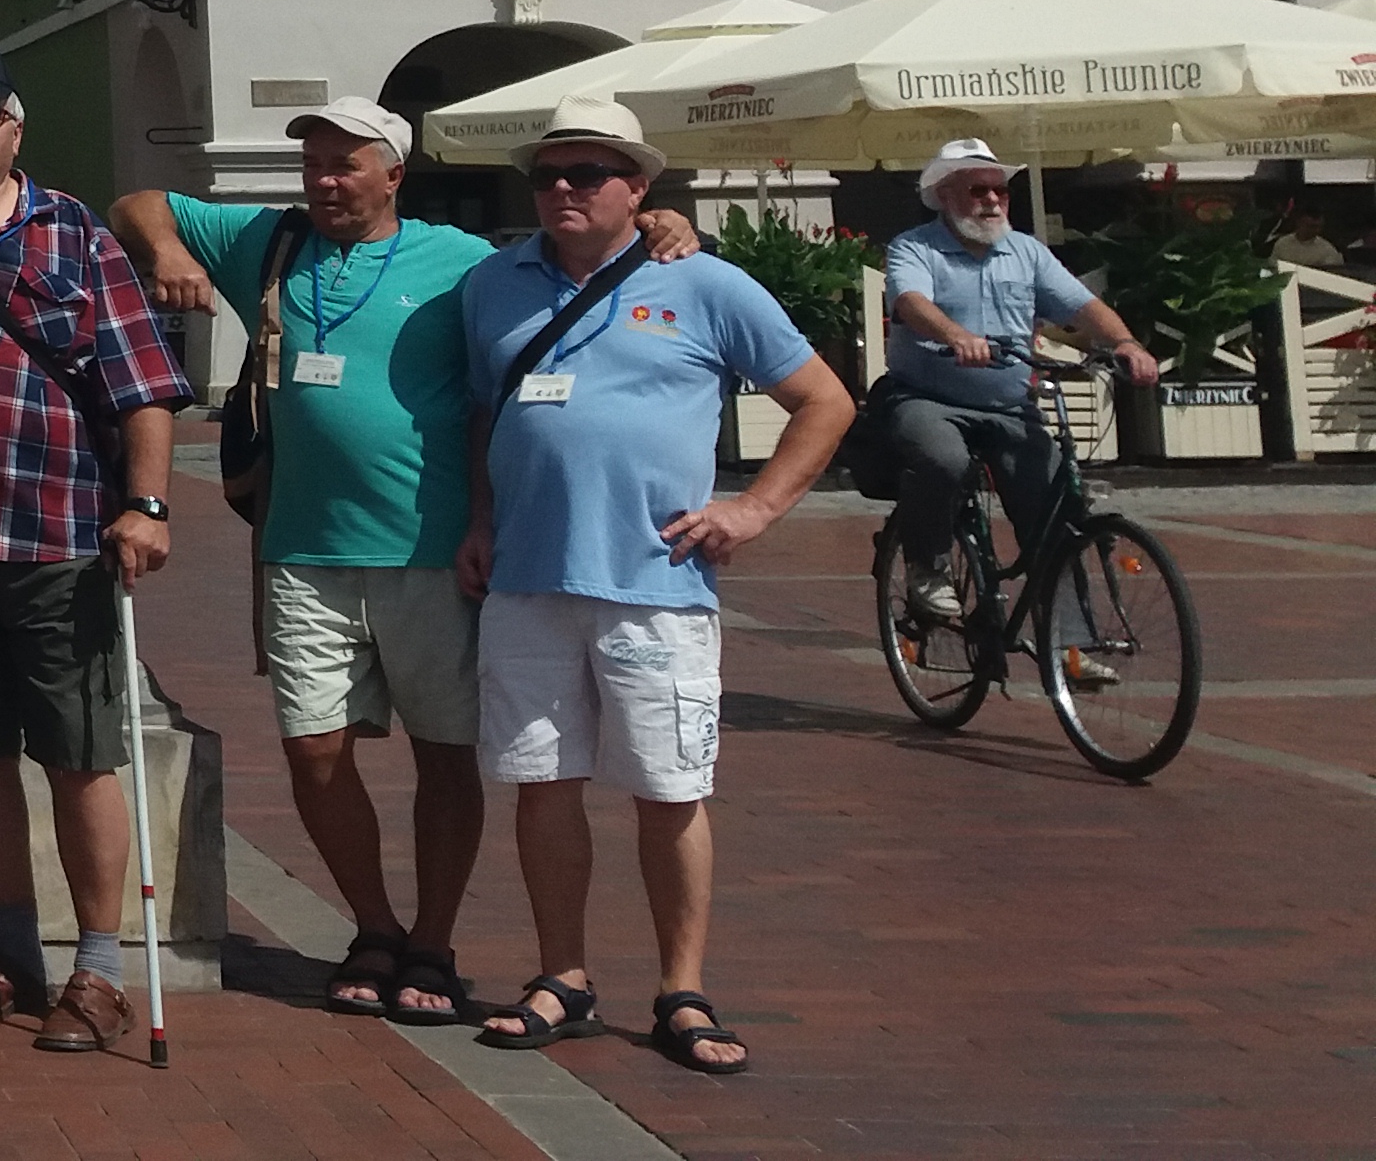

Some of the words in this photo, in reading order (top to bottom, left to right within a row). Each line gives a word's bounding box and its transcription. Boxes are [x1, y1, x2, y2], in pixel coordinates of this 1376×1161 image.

[897, 63, 1066, 100] Ormiańskie
[1082, 59, 1203, 93] Piwnice
[687, 97, 776, 125] ZWIERZYNIEC
[444, 120, 526, 138] RESTAURACJA
[1225, 139, 1331, 156] ZWIERZYNIEC
